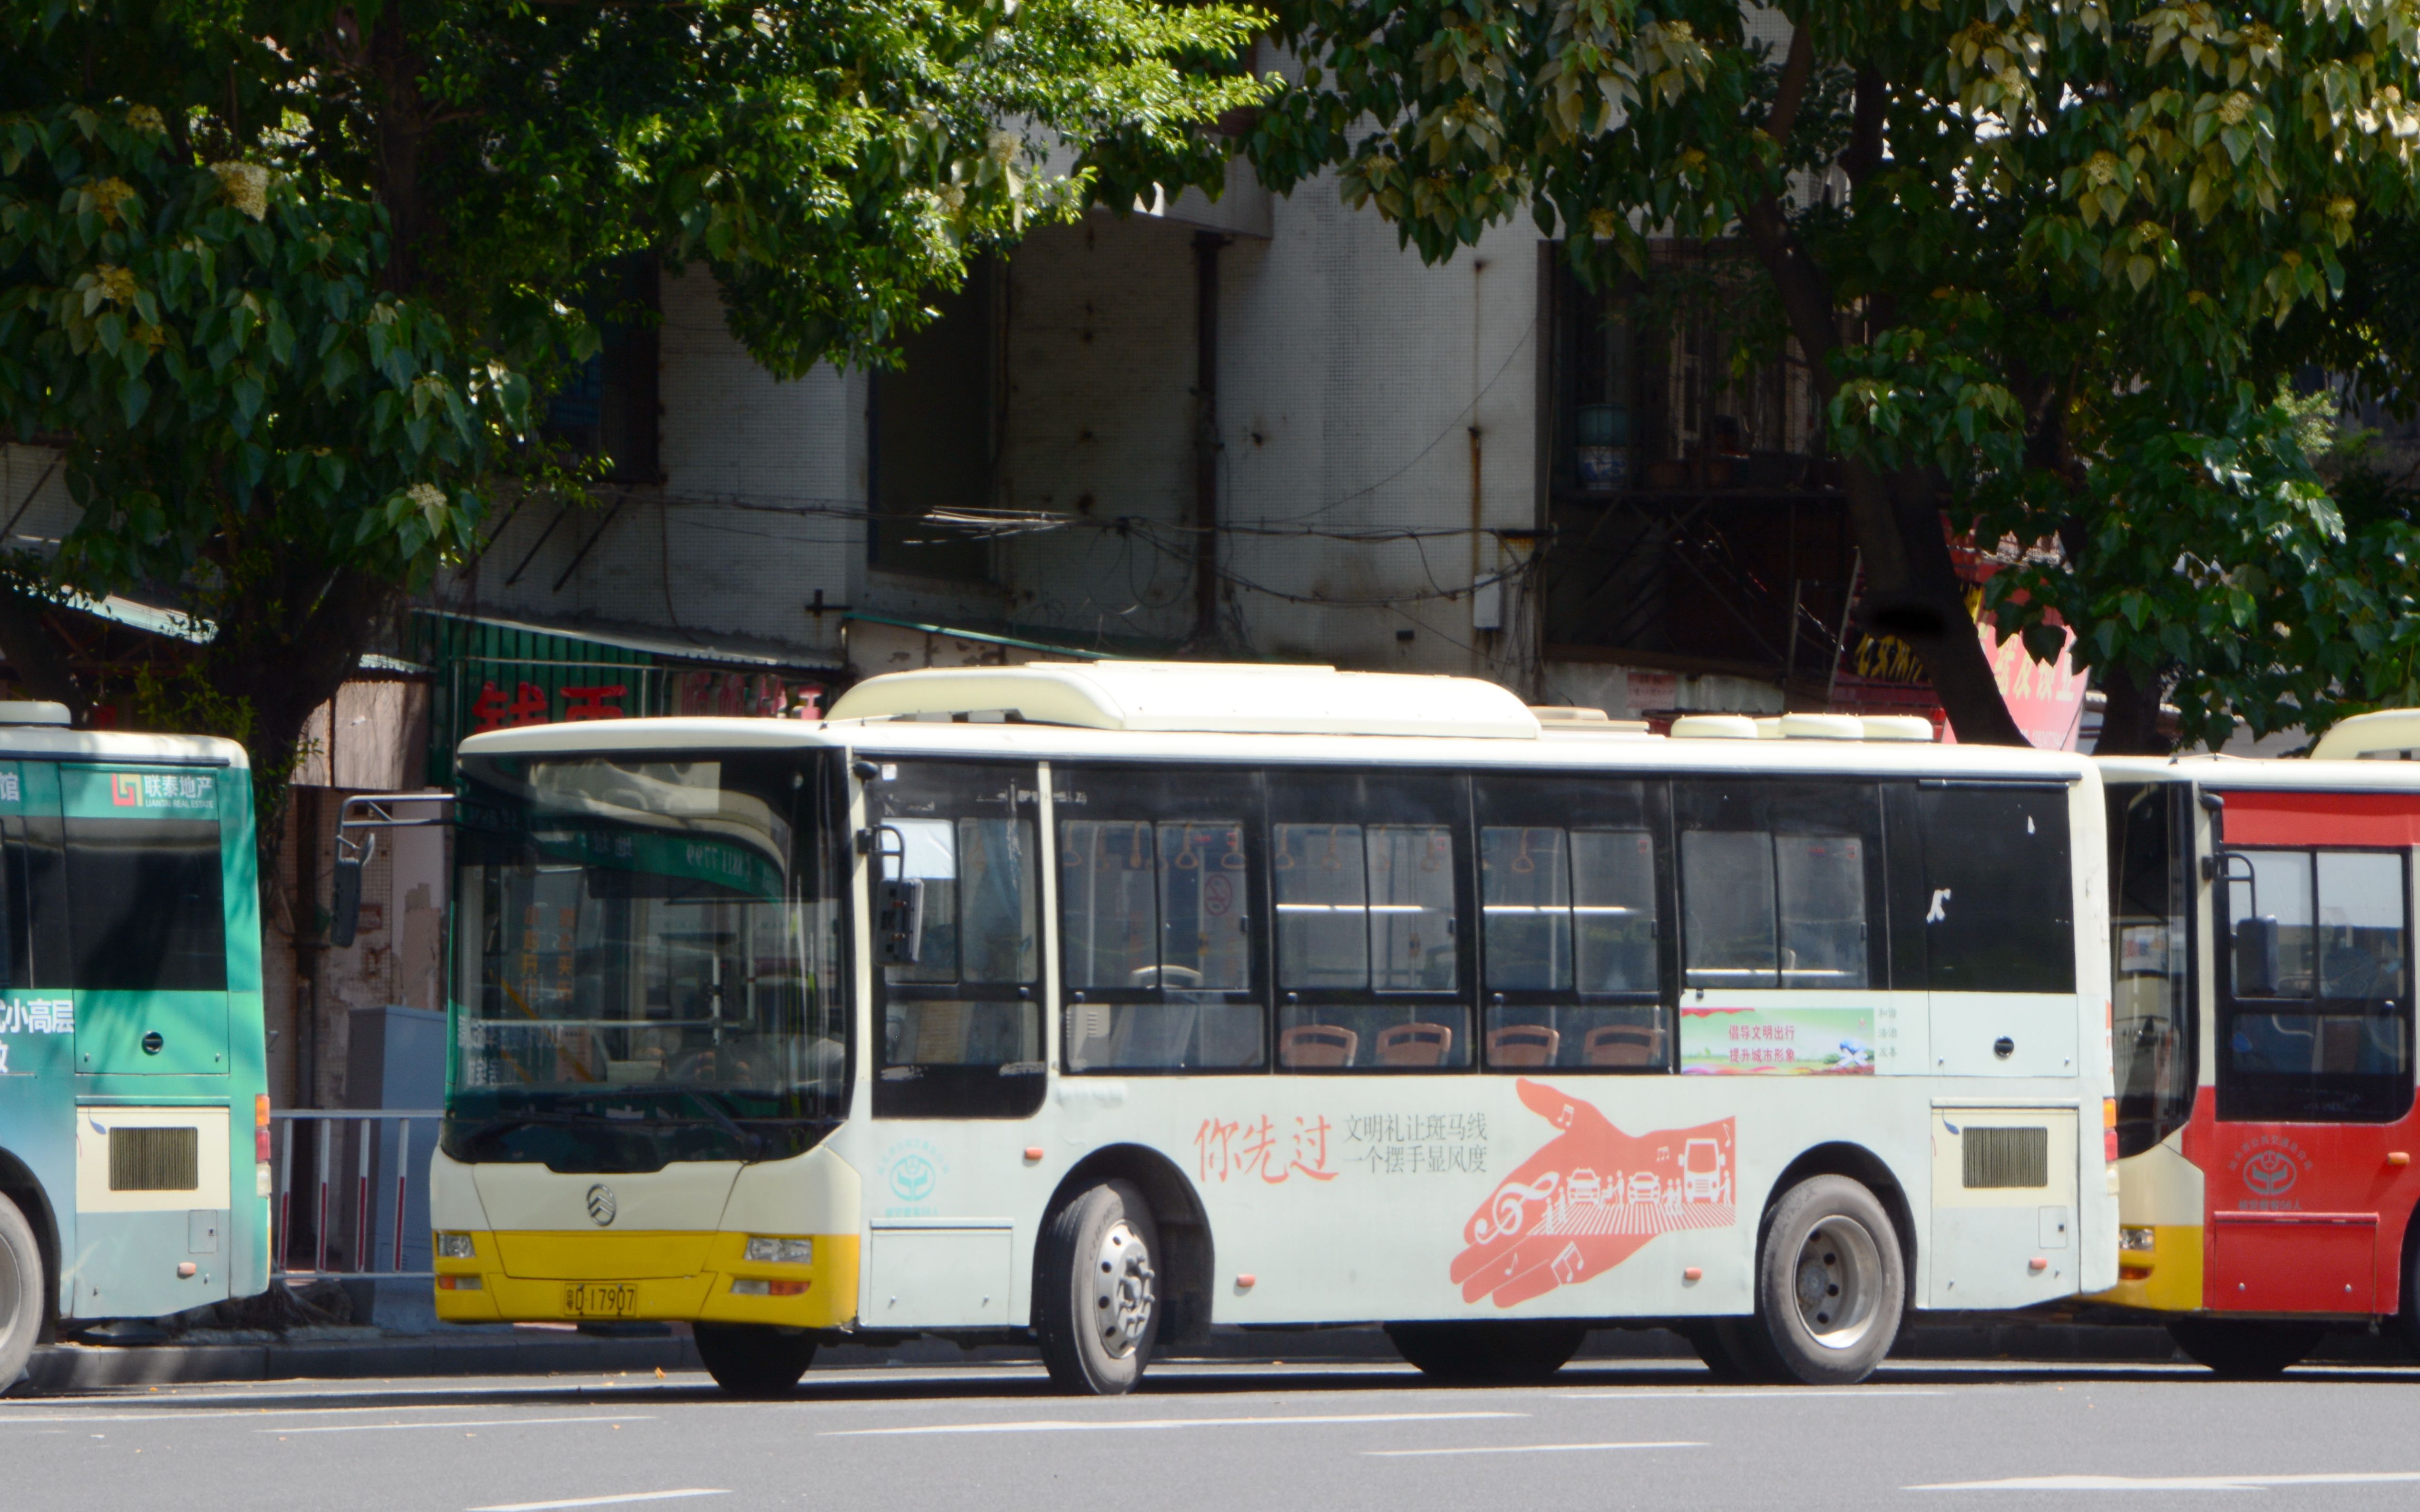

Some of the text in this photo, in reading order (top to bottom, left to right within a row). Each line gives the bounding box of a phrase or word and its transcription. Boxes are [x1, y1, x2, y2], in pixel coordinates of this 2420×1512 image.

[144, 775, 212, 798] 联泰地产
[173, 799, 189, 808] REAL
[191, 800, 214, 808] ESTATE
[1878, 1007, 1897, 1018] 和谐
[1729, 1024, 1795, 1040] 倡导文明出行
[1878, 1027, 1897, 1038] 法治
[1729, 1047, 1795, 1063] 提升城市形象
[1343, 1112, 1488, 1143] 文明礼让斑马线
[1194, 1113, 1339, 1184] 你先过
[1343, 1144, 1488, 1174] 一个摆手显风度
